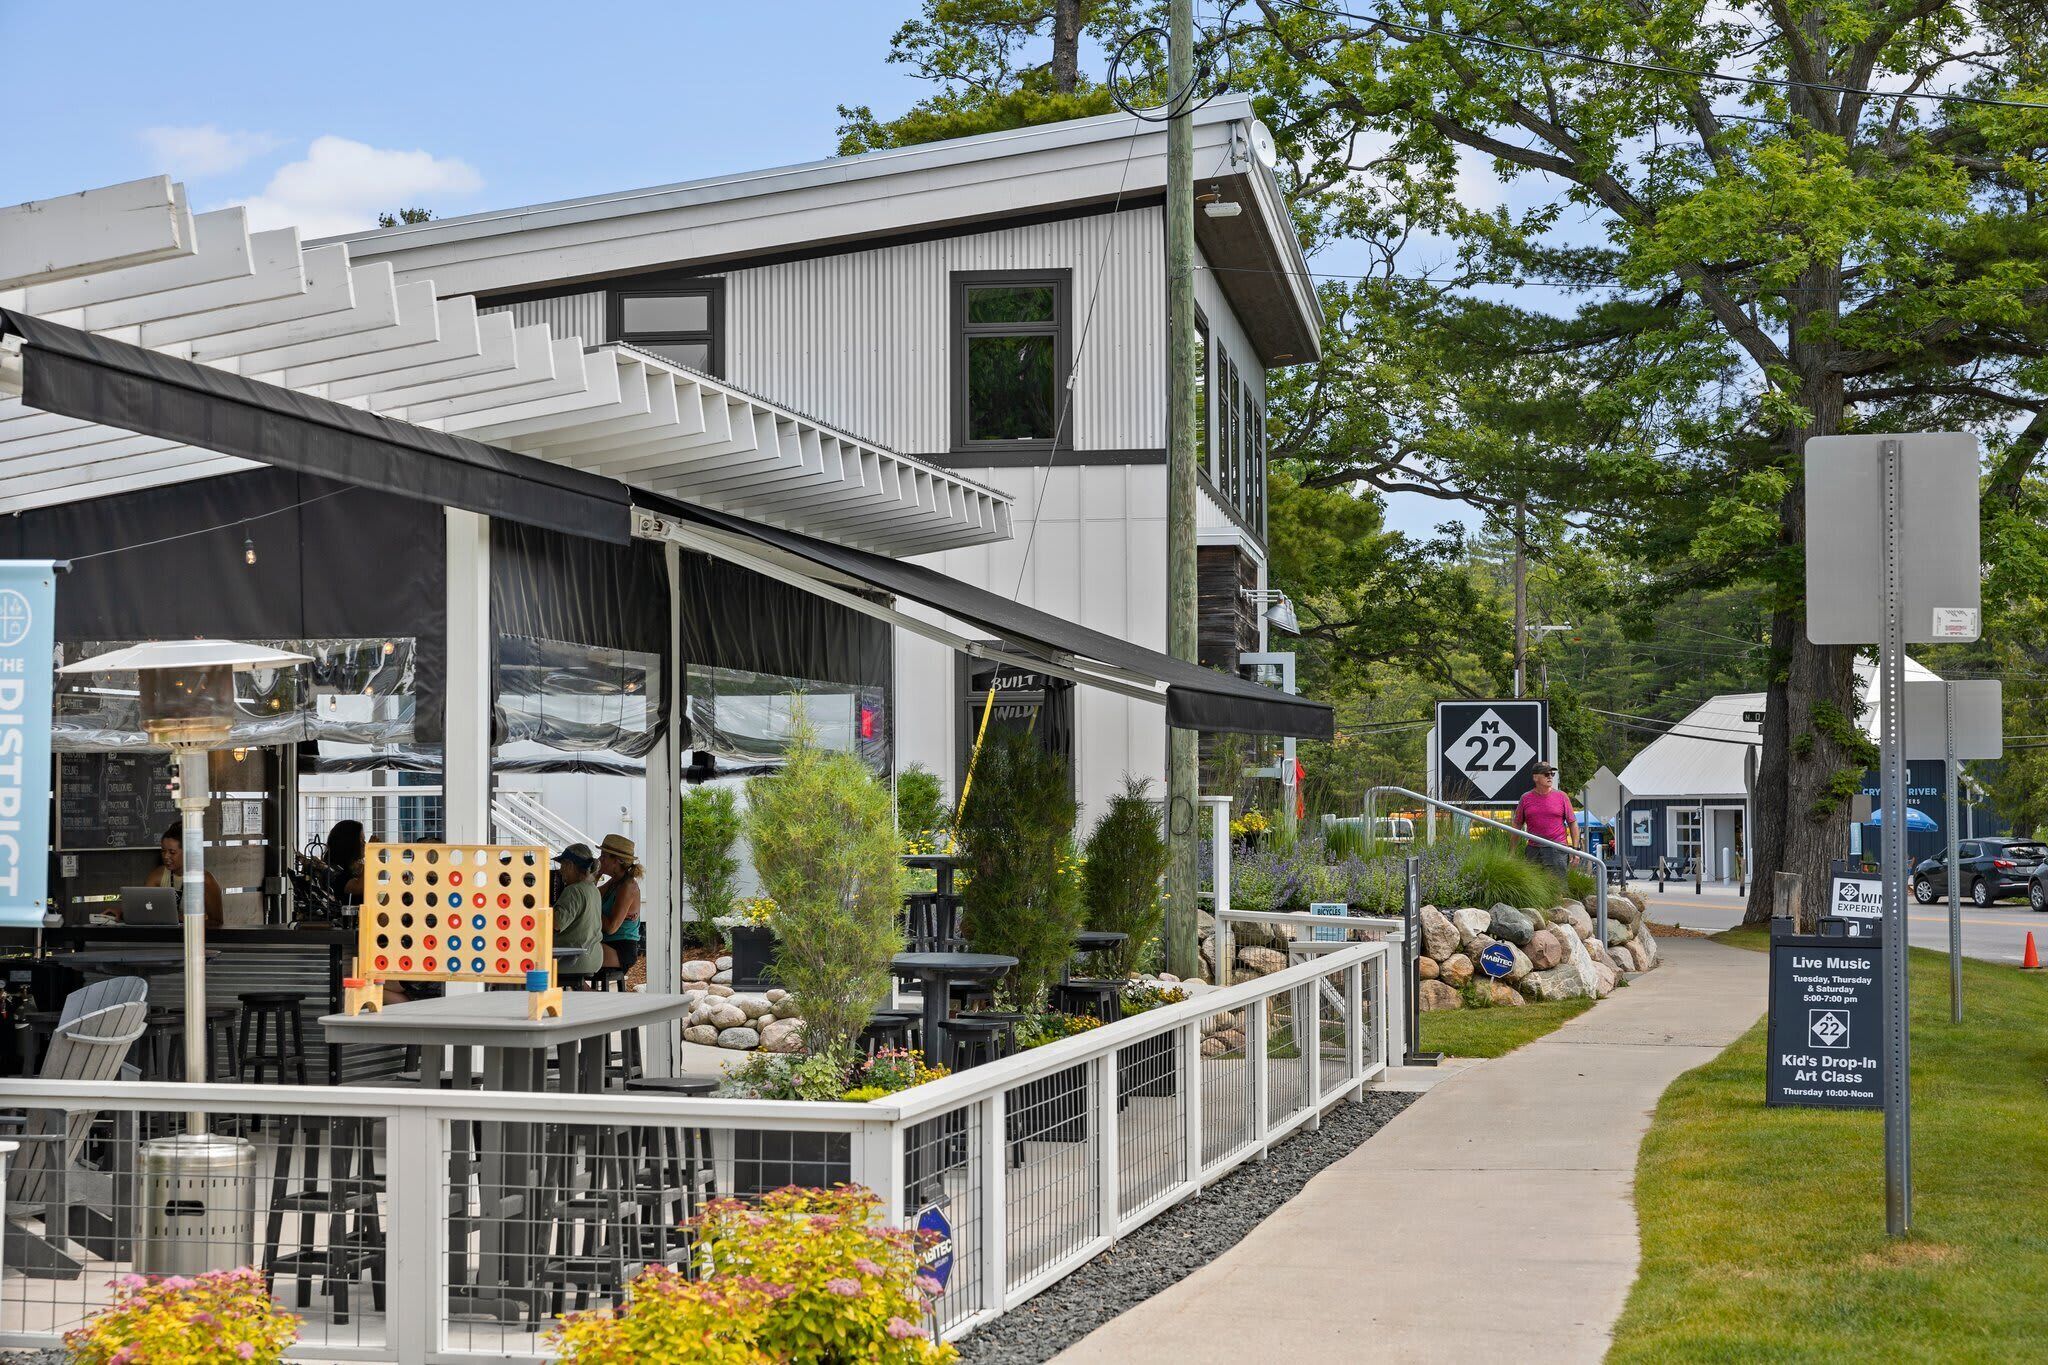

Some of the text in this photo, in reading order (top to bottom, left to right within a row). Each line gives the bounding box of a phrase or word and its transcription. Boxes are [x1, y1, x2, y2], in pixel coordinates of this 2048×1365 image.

[991, 674, 1037, 691] BUILT
[1481, 721, 1499, 734] M
[1465, 736, 1516, 771] 22
[1908, 788, 1937, 796] RIVER
[1838, 903, 1882, 913] EXPERIEN
[1482, 954, 1513, 967] HABITEC
[1792, 957, 1871, 970] Live Music
[1793, 975, 1872, 985] Tuesday, Thursday
[1815, 985, 1854, 994] Saturday
[1803, 995, 1858, 1004] 5:00-7:00 pm
[1819, 1023, 1840, 1036] 22
[1782, 1055, 1877, 1070] Kid's Drop-In
[1794, 1070, 1862, 1083] Art Class
[1783, 1088, 1874, 1098] Thursday 10:00-Noon
